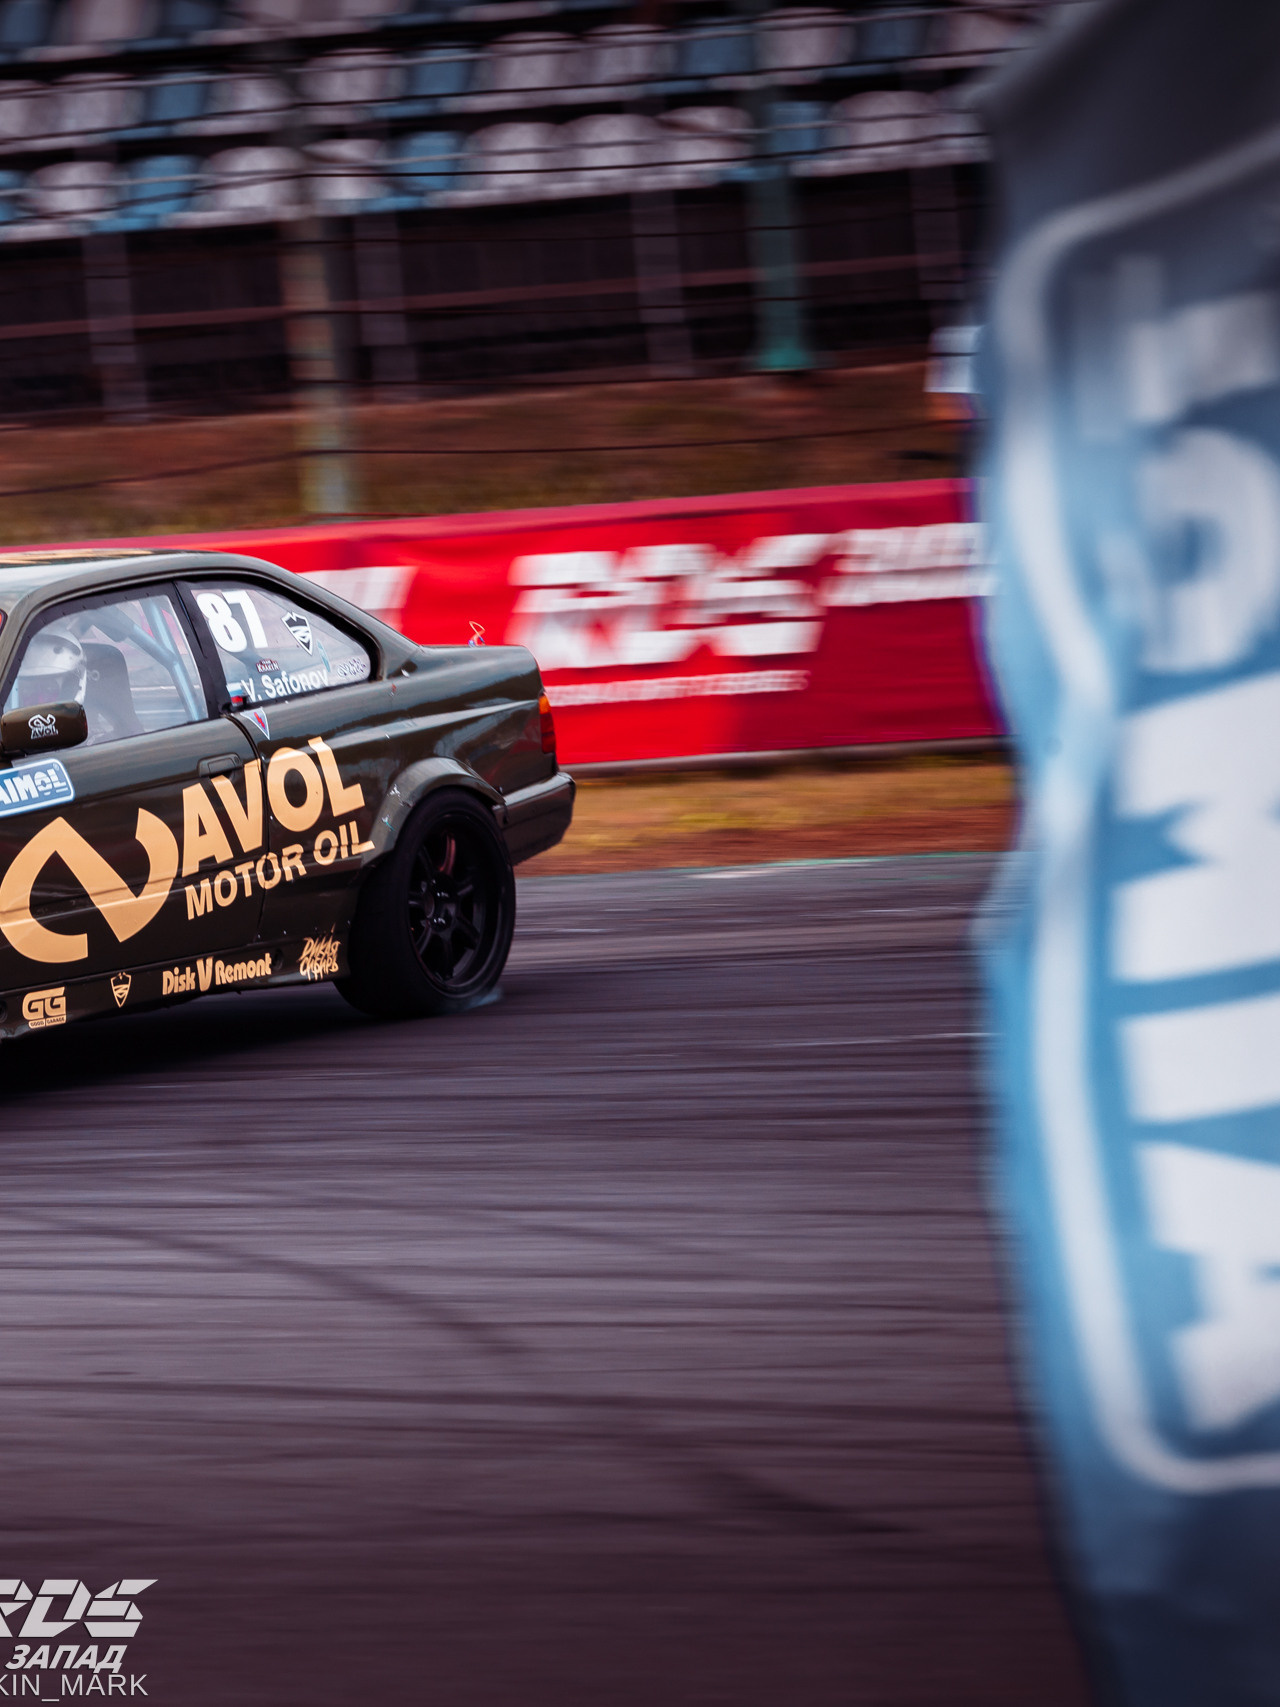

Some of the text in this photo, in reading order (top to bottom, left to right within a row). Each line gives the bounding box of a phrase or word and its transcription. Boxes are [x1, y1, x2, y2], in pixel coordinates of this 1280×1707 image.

[196, 590, 269, 653] 87
[241, 670, 329, 702] V. Safonov
[181, 736, 366, 877] AVOL
[184, 820, 376, 921] MOTOR OIL
[162, 953, 272, 995] Disk V Remont
